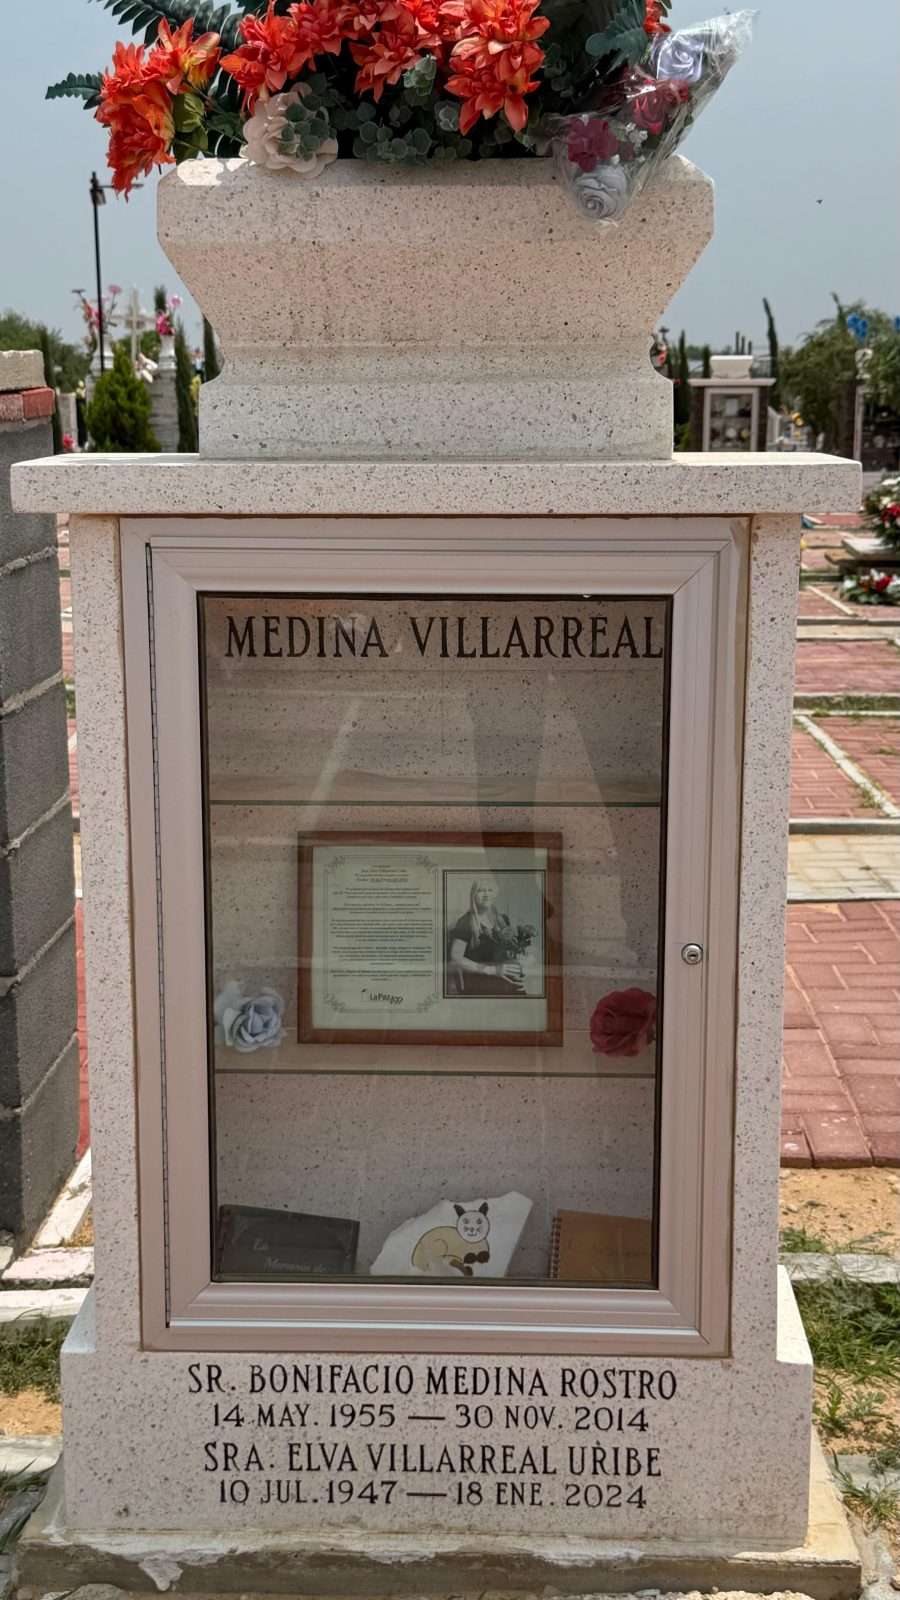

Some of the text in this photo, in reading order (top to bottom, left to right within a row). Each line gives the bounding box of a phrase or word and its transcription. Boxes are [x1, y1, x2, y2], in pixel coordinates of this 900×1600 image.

[224, 615, 663, 659] MEDINA VILLARREAL
[188, 1362, 677, 1401] SR. BONIFACIO MEDINA ROSTRO
[213, 1402, 245, 1428] 14
[257, 1403, 320, 1428] MAY.
[329, 1403, 396, 1429] 1955
[455, 1403, 494, 1429] 30
[504, 1405, 562, 1430] NOV.
[574, 1406, 649, 1433] 2014
[204, 1440, 662, 1477] SRA. ELVA VILLARREAL URIBE
[219, 1479, 250, 1506] 10
[260, 1479, 318, 1505] JUL.
[325, 1479, 398, 1505] 1947
[456, 1481, 484, 1507] 18
[495, 1481, 556, 1507] ENE.
[564, 1483, 647, 1509] 2024
